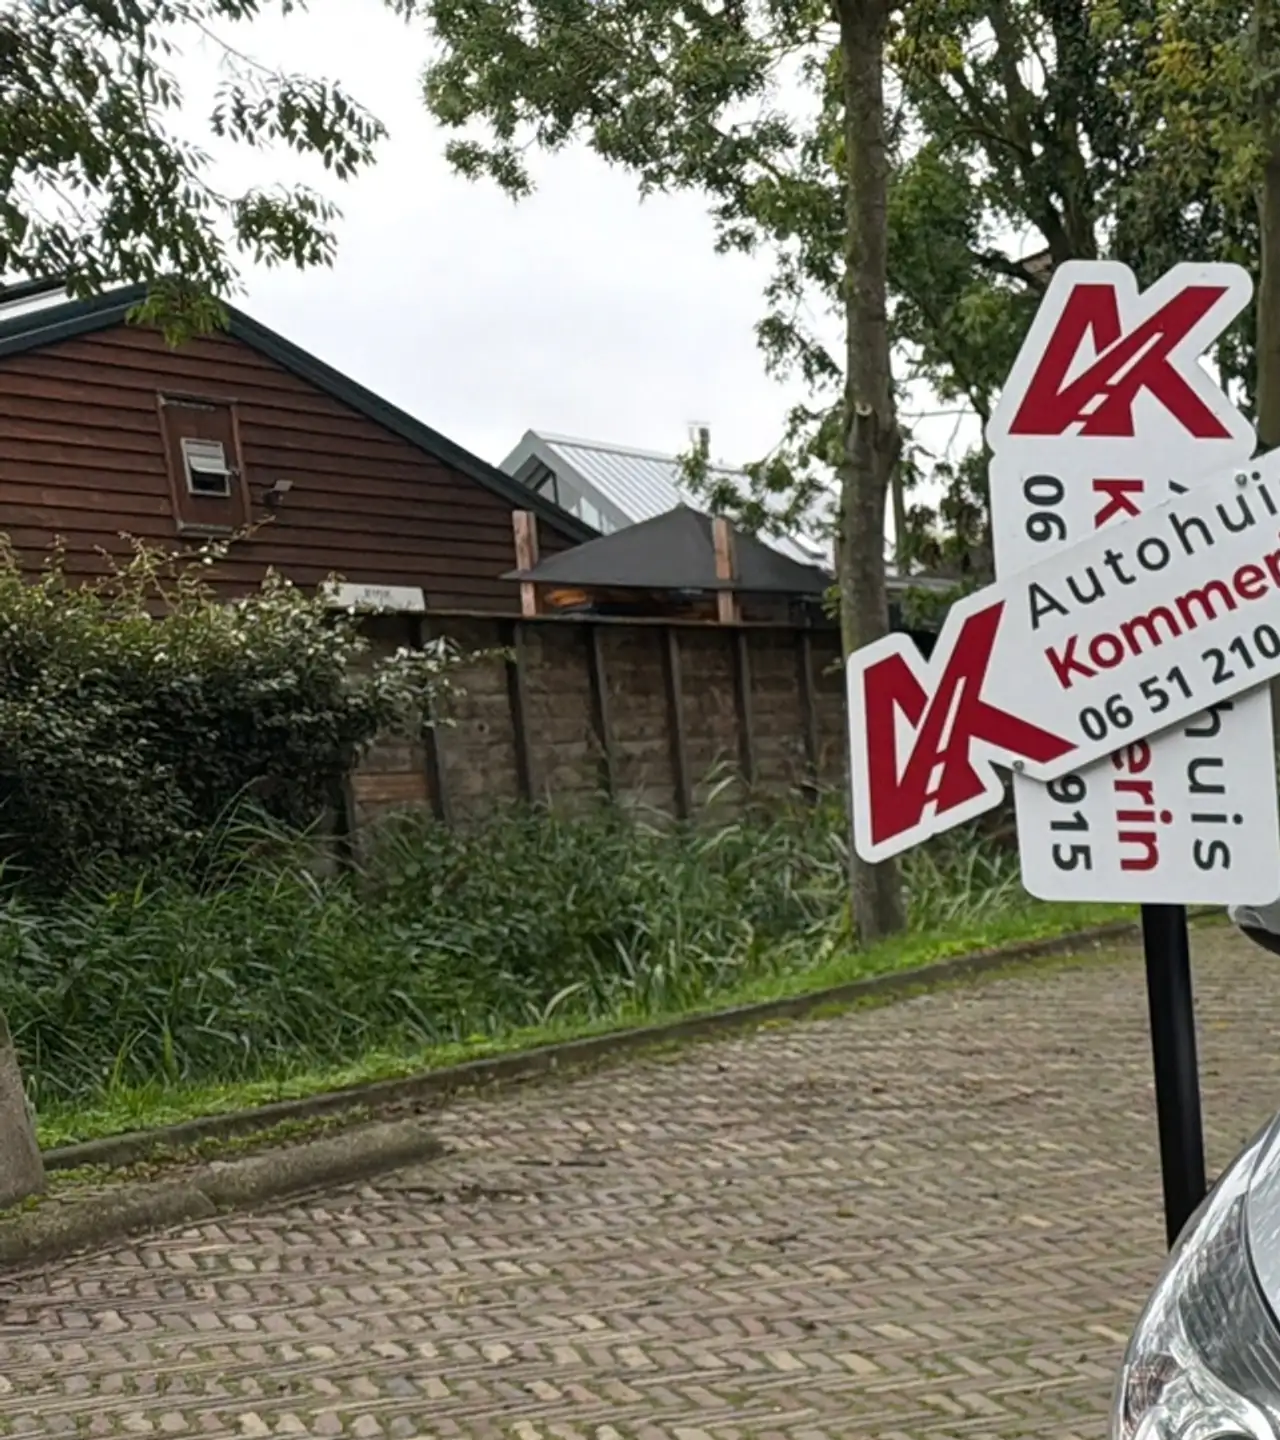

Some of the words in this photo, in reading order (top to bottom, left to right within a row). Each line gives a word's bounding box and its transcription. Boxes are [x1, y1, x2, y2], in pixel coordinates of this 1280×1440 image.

[1023, 474, 1067, 542] 06
[1046, 774, 1092, 871] 915
[1078, 693, 1134, 741] 06
[1139, 666, 1193, 713] 51
